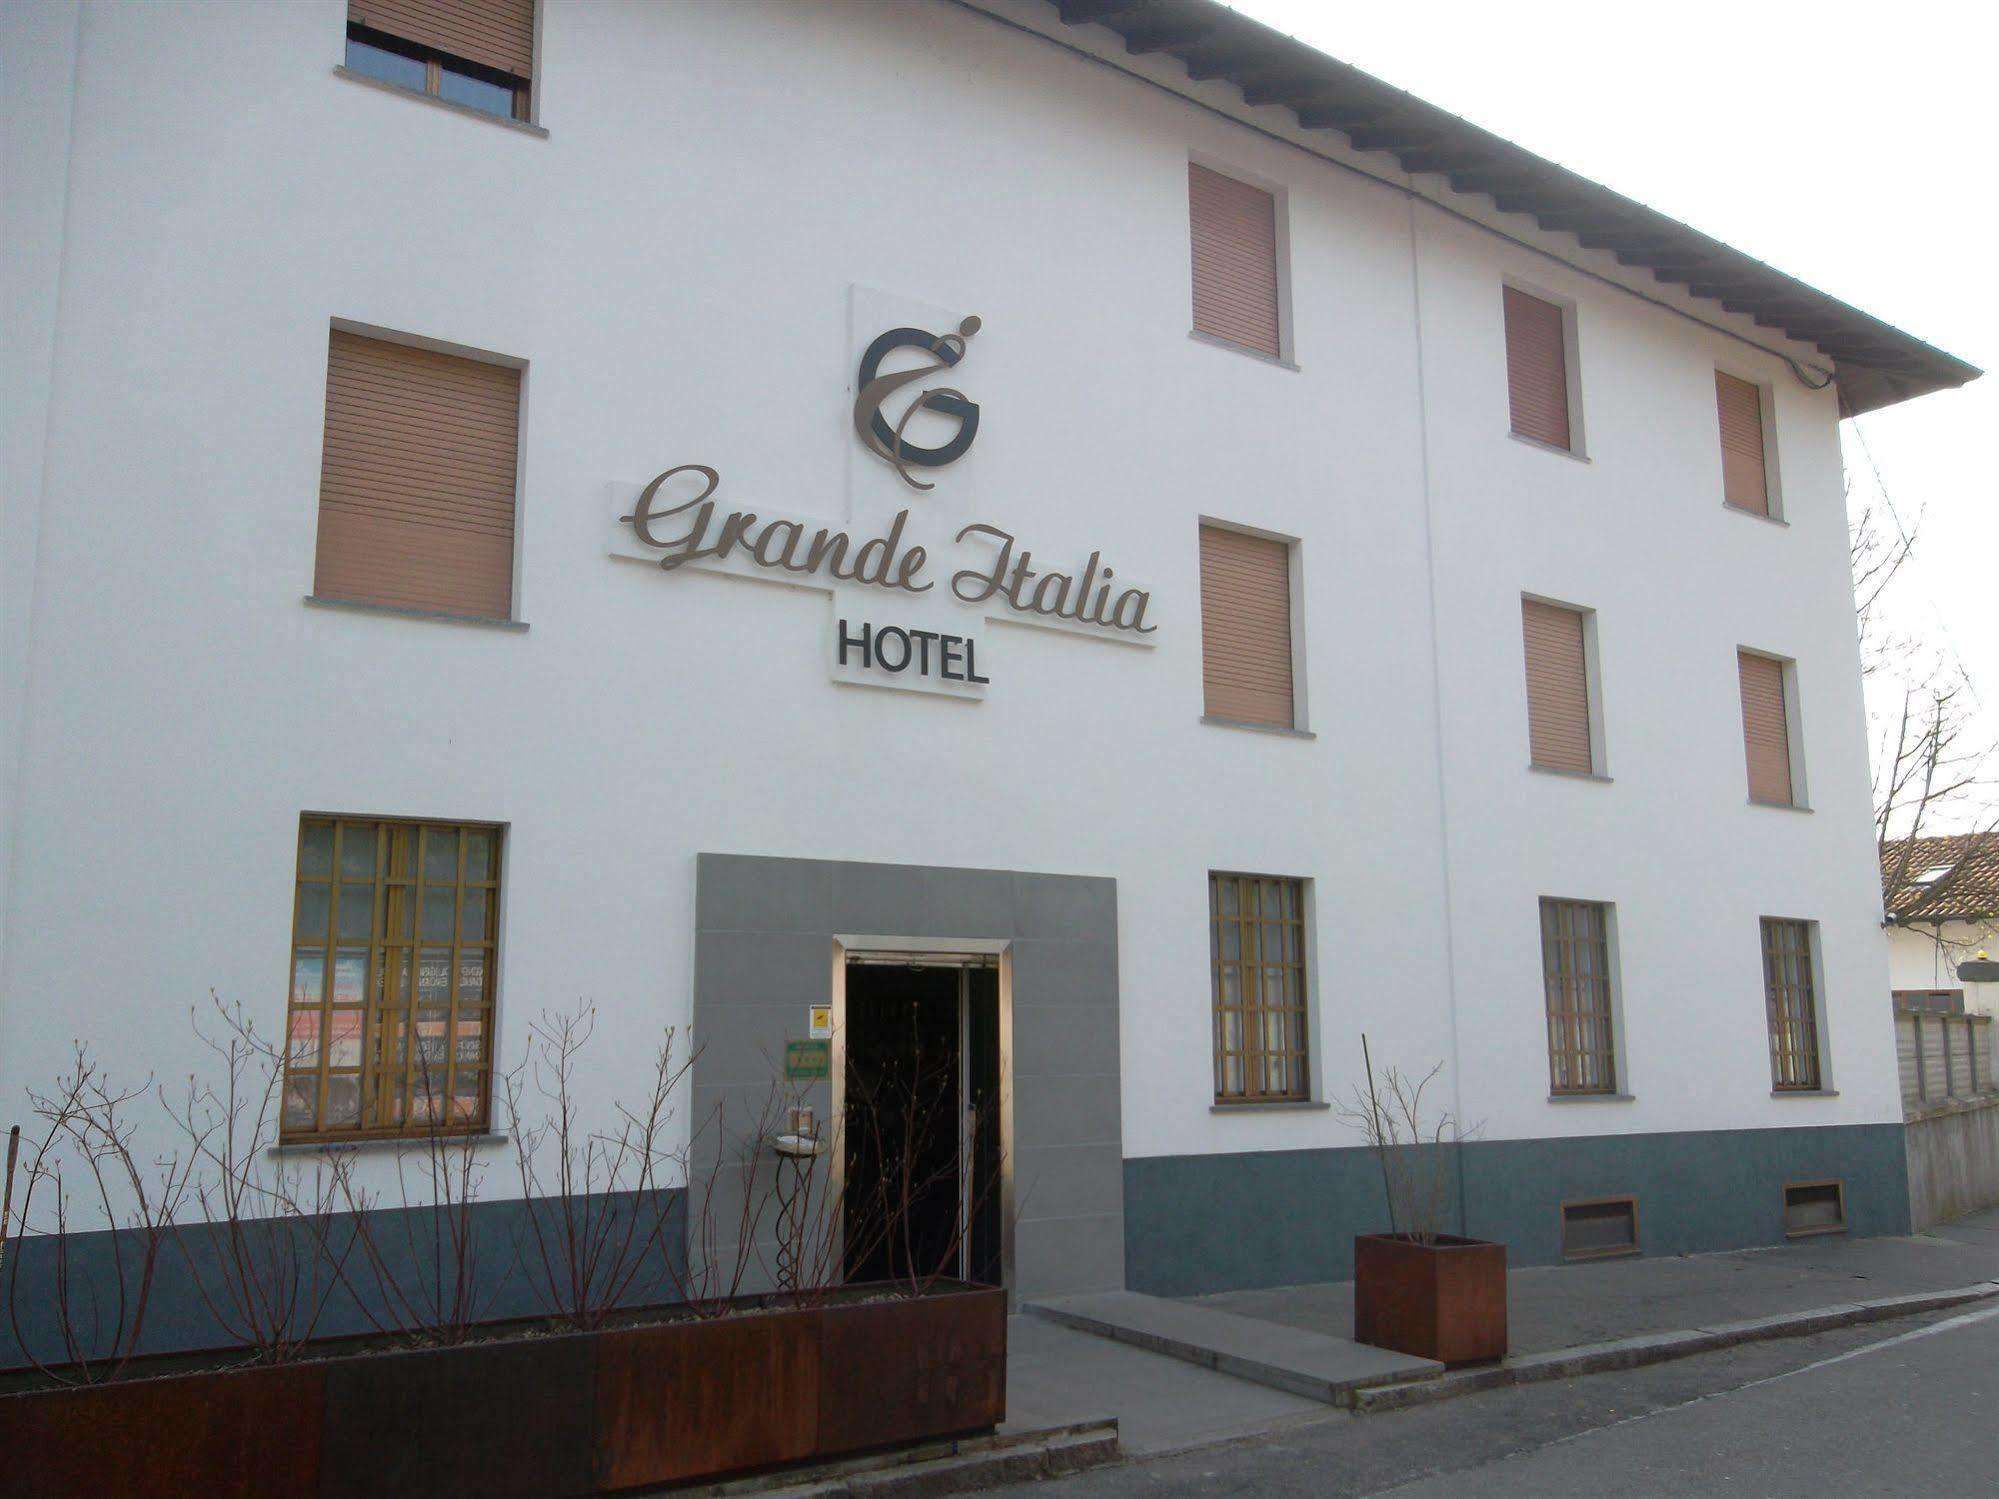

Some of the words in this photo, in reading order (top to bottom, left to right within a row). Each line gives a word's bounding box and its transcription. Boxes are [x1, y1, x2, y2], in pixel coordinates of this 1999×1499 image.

[619, 464, 934, 593] Grande
[951, 523, 1158, 633] Italia
[838, 619, 990, 684] HOTEL
